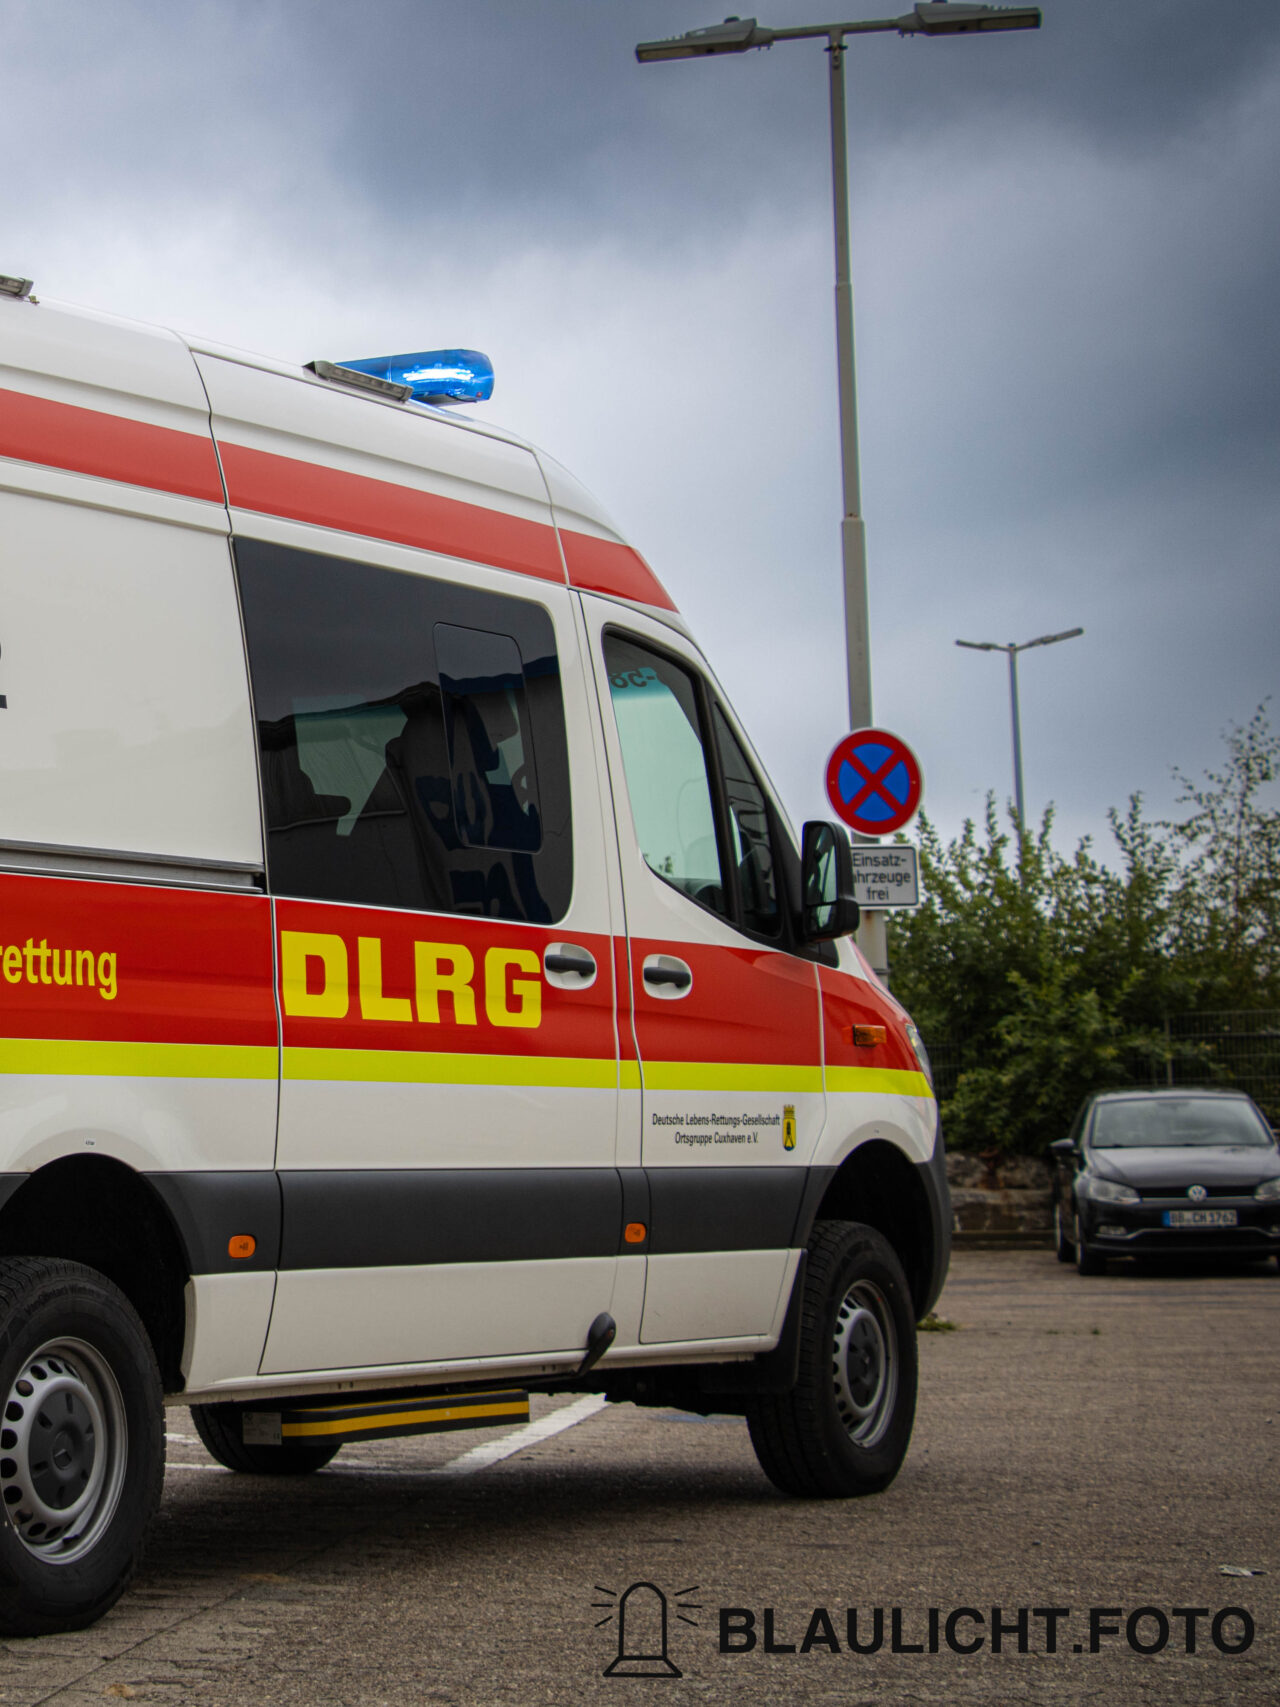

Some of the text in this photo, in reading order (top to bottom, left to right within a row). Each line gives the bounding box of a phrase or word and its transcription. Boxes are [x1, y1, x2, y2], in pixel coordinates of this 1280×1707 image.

[852, 852, 907, 867] Einsatz-
[866, 886, 889, 901] frei
[280, 930, 541, 1028] DLRG
[652, 1113, 780, 1128] Deutsche Lebens-Rettungs-Gesellschaft
[674, 1131, 712, 1147] Ortsgruppe
[714, 1131, 745, 1144] Cuxhaven
